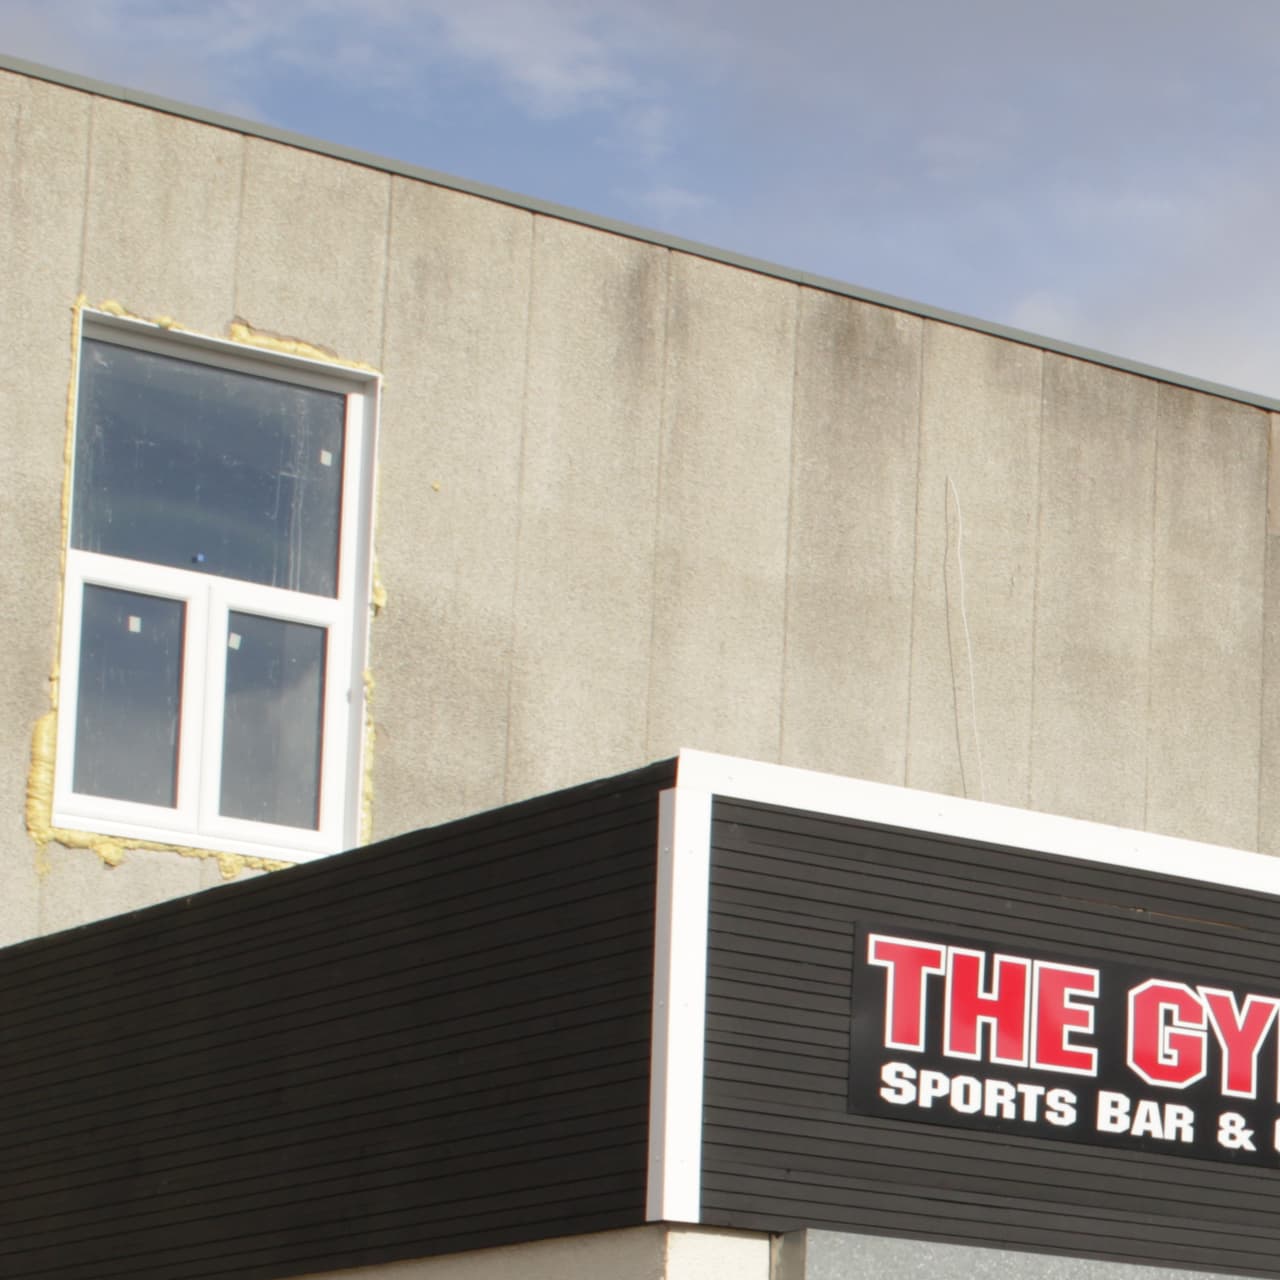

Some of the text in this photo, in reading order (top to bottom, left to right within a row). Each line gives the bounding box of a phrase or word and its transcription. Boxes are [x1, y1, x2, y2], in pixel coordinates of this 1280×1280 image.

[868, 933, 1100, 1077] THE
[880, 1061, 1077, 1127] SPORTS
[1097, 1090, 1195, 1143] BAR
[1217, 1111, 1257, 1151] &
